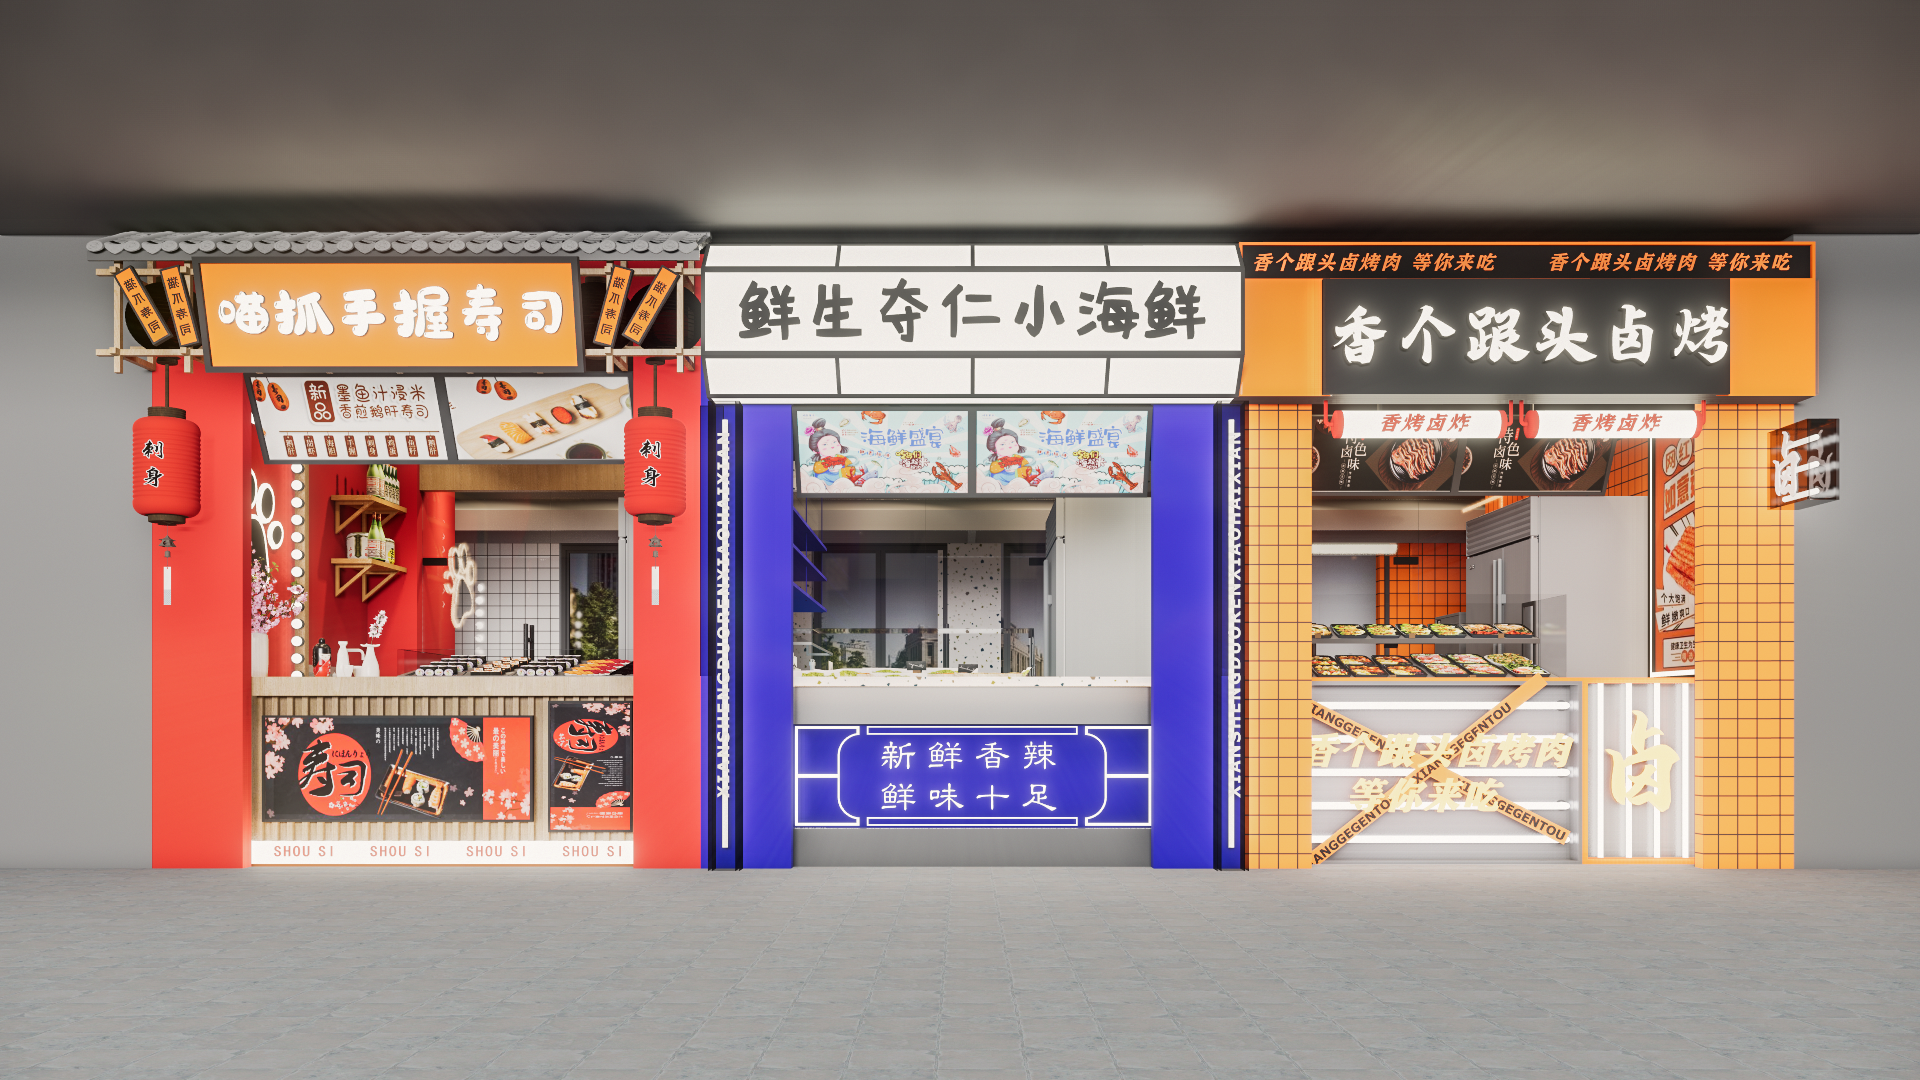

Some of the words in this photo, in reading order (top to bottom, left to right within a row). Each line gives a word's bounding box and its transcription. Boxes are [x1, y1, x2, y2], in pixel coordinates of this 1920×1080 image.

[1253, 252, 1402, 272] 香个跟头卤烤肉
[1412, 252, 1497, 272] 等你来吃
[1549, 252, 1698, 272] 香个跟头卤烤肉
[1708, 252, 1793, 272] 等你来吃
[217, 283, 563, 342] 喵抓手握寿司
[738, 278, 1206, 342] 鲜生夺仁小海鲜
[1333, 304, 1730, 366] 香个跟头卤烤
[308, 382, 332, 421] 新品
[336, 383, 426, 403] 墨鱼汁浸米
[339, 404, 429, 420] 香煎鹅肝寿司
[1381, 413, 1472, 433] 香烤卤炸
[1572, 413, 1663, 433] 香烤卤炸
[860, 425, 944, 449] 海鲜盛宴
[1038, 425, 1122, 449] 海鲜盛宴
[142, 439, 165, 488] 刺身
[639, 439, 662, 488] 刺身
[1665, 468, 1695, 514] 如意
[716, 432, 731, 798] XIANSHENGDUORENXIAOHAIXIAN
[1228, 432, 1242, 798] XIANSHENGDUORENXIAOHAIXIAN
[880, 741, 1056, 770] 新鲜香辣
[1311, 732, 1574, 769] 香个跟头卤烤肉
[1604, 709, 1680, 813] 卤
[299, 739, 367, 797] 寿司
[880, 782, 1057, 812] 鲜味十足
[1350, 777, 1505, 813] 等你来吃
[274, 845, 310, 857] SHOU
[318, 845, 334, 857] SI
[370, 845, 406, 857] SHOU
[414, 845, 430, 857] SI
[466, 845, 503, 857] SHOU
[510, 845, 526, 857] SI
[562, 845, 599, 857] SHOU
[607, 845, 622, 857] SI
